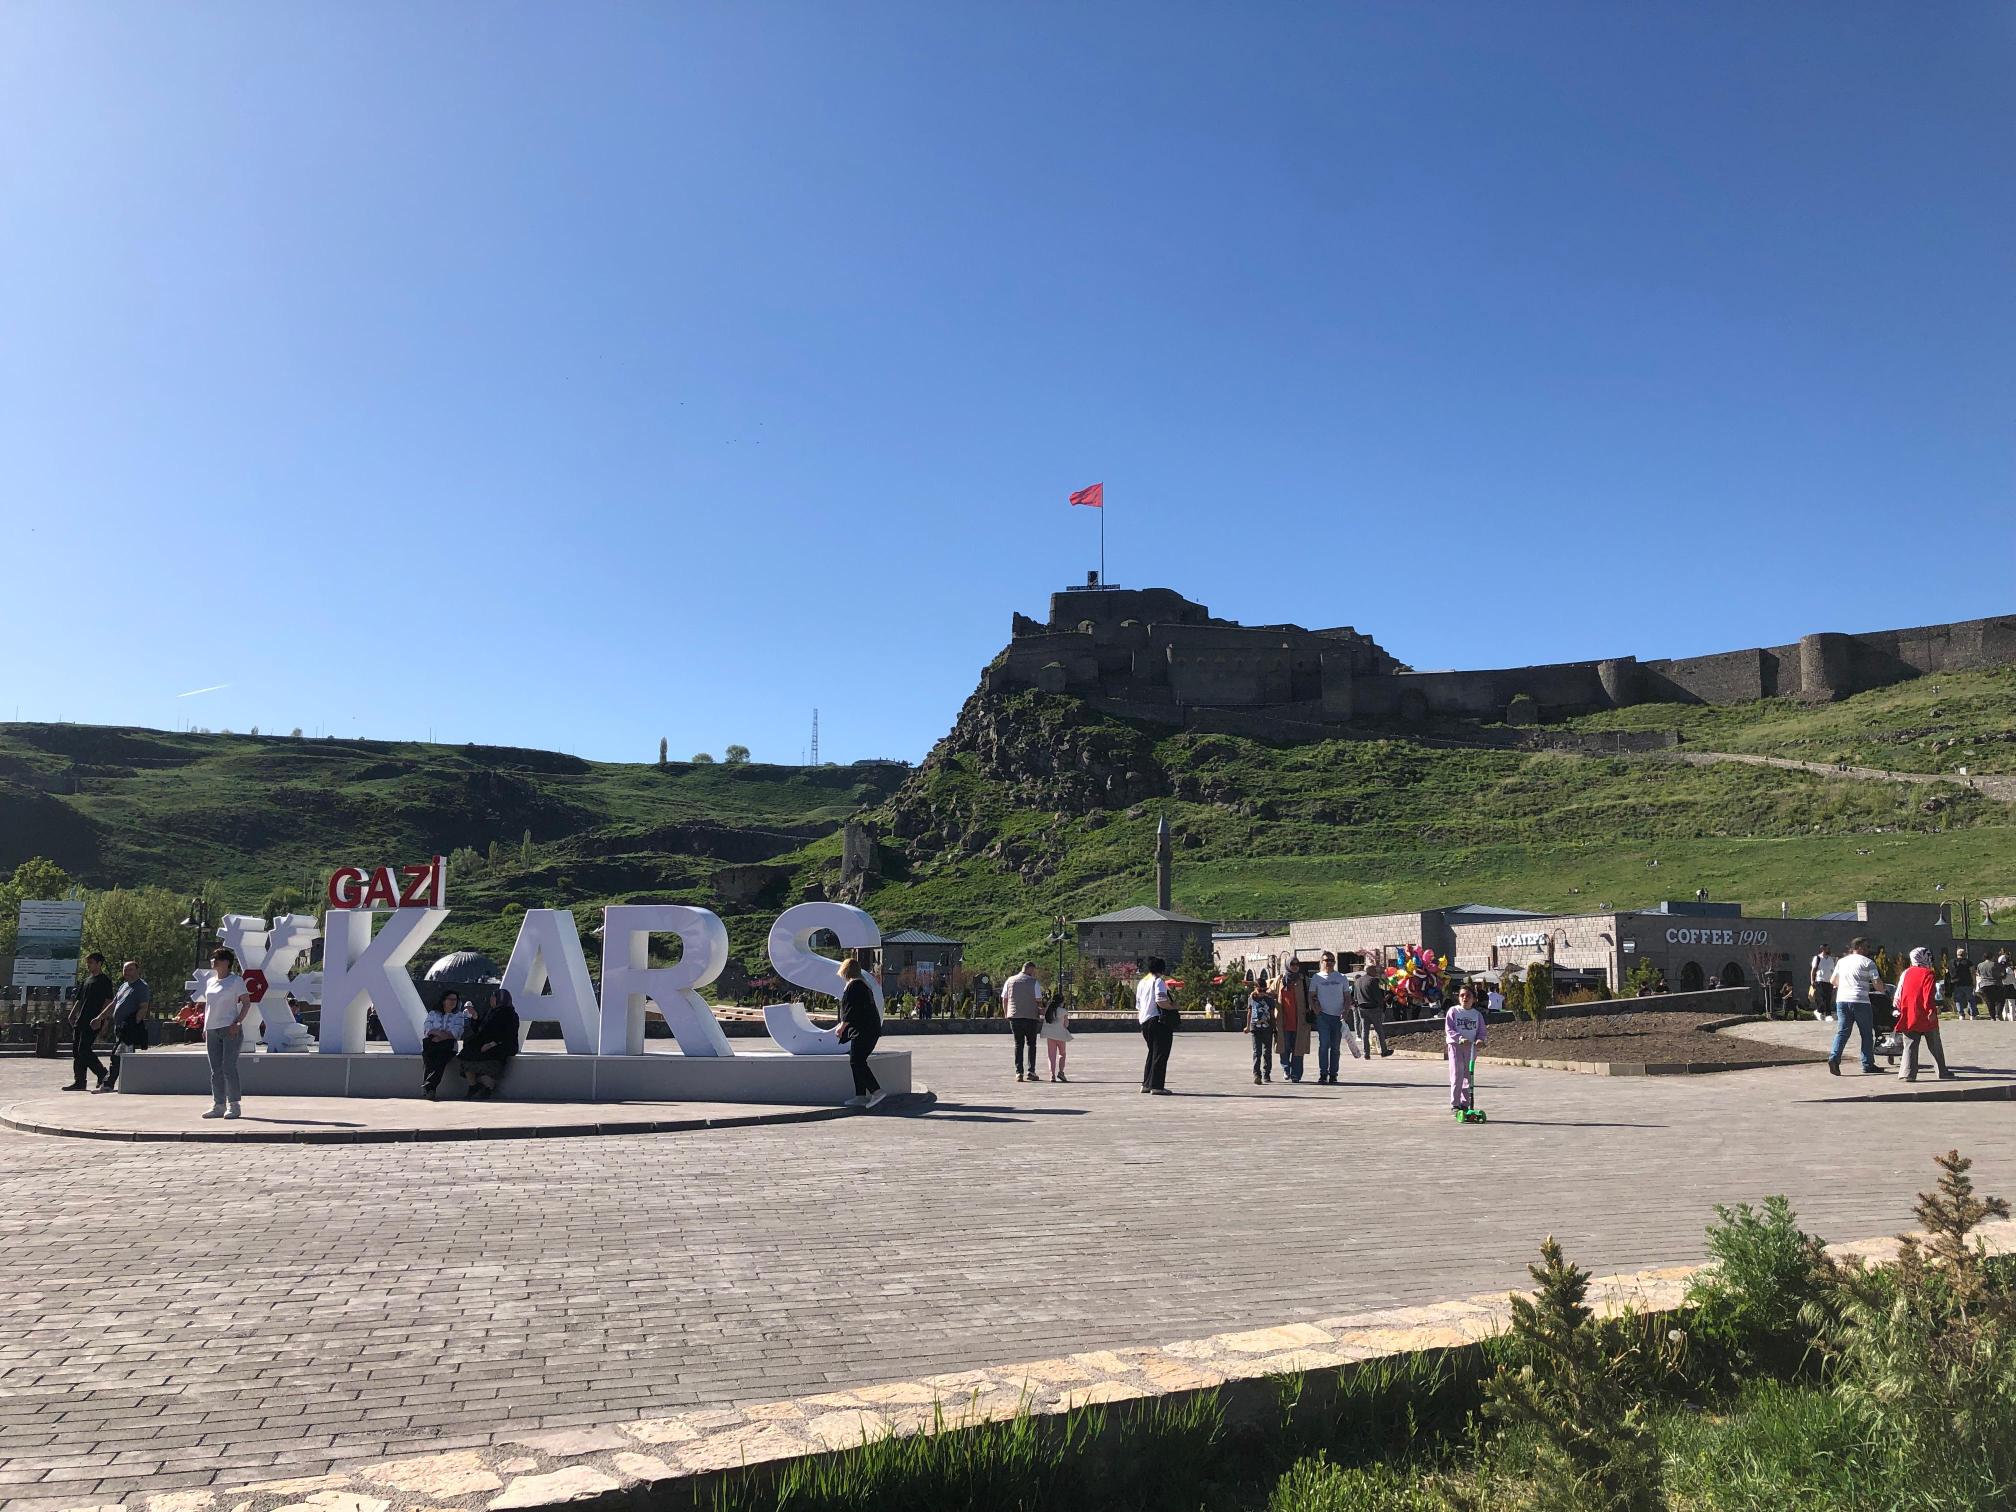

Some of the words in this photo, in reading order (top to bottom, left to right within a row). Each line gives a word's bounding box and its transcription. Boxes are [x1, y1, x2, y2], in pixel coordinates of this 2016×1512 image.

[328, 855, 447, 909] GAZİ
[1665, 928, 1733, 945] COFFEE
[318, 901, 884, 1057] KARS
